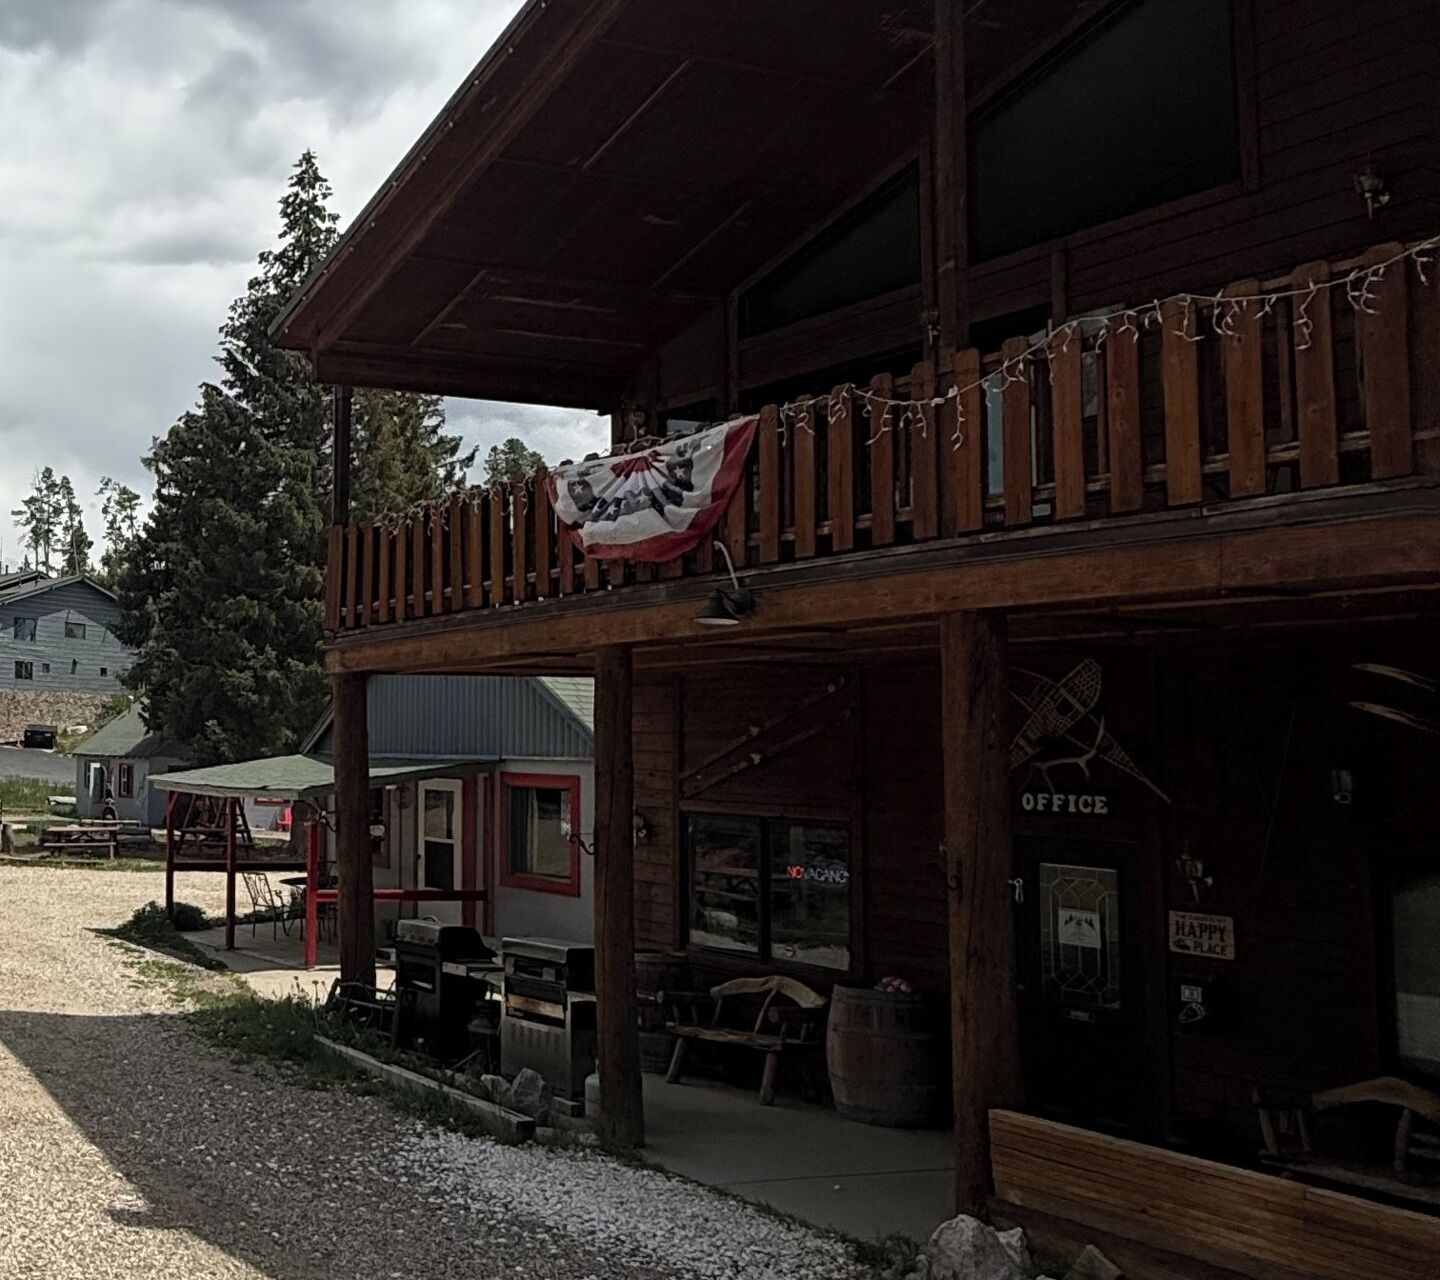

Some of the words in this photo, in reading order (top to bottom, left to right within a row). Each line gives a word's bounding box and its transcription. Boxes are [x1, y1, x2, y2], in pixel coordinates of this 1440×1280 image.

[1021, 792, 1109, 815] OFFICE
[787, 865, 806, 879] NO
[1174, 920, 1227, 942] HAPPY
[1193, 941, 1227, 956] PLACE
